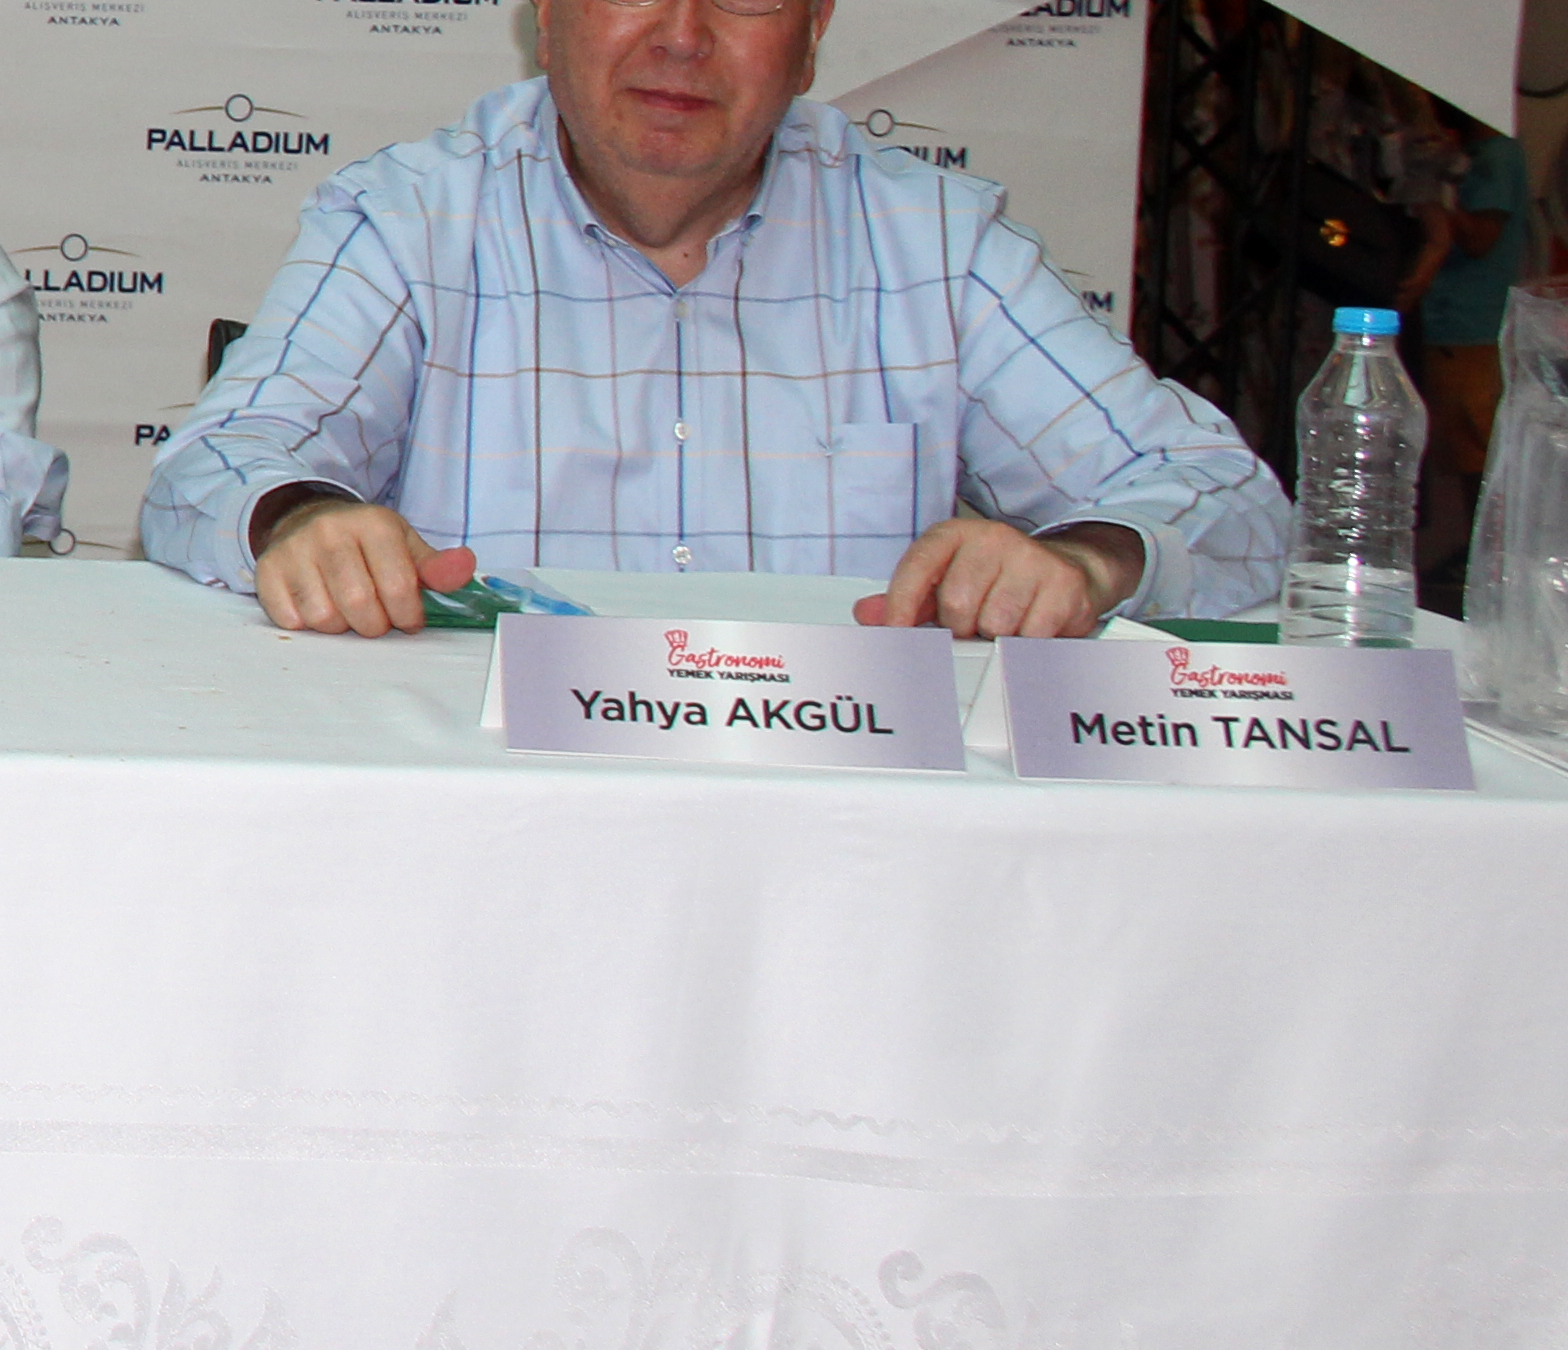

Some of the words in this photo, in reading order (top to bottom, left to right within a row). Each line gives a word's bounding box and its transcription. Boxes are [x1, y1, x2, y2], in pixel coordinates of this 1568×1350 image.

[370, 25, 442, 34] ANTAKYA
[147, 129, 329, 155] PALLADIUM
[668, 646, 785, 669] Gastronomi
[667, 668, 714, 679] YEMEK
[719, 670, 790, 683] YARIŞMASI
[1170, 664, 1287, 687] Gastronomi
[1169, 688, 1217, 699] YEMEK
[1221, 689, 1294, 701] YARIŞMASI
[571, 689, 707, 730] Yahya
[727, 695, 894, 734] AKGÜL
[1070, 712, 1197, 746] Metin
[1213, 717, 1411, 753] TANSAL
